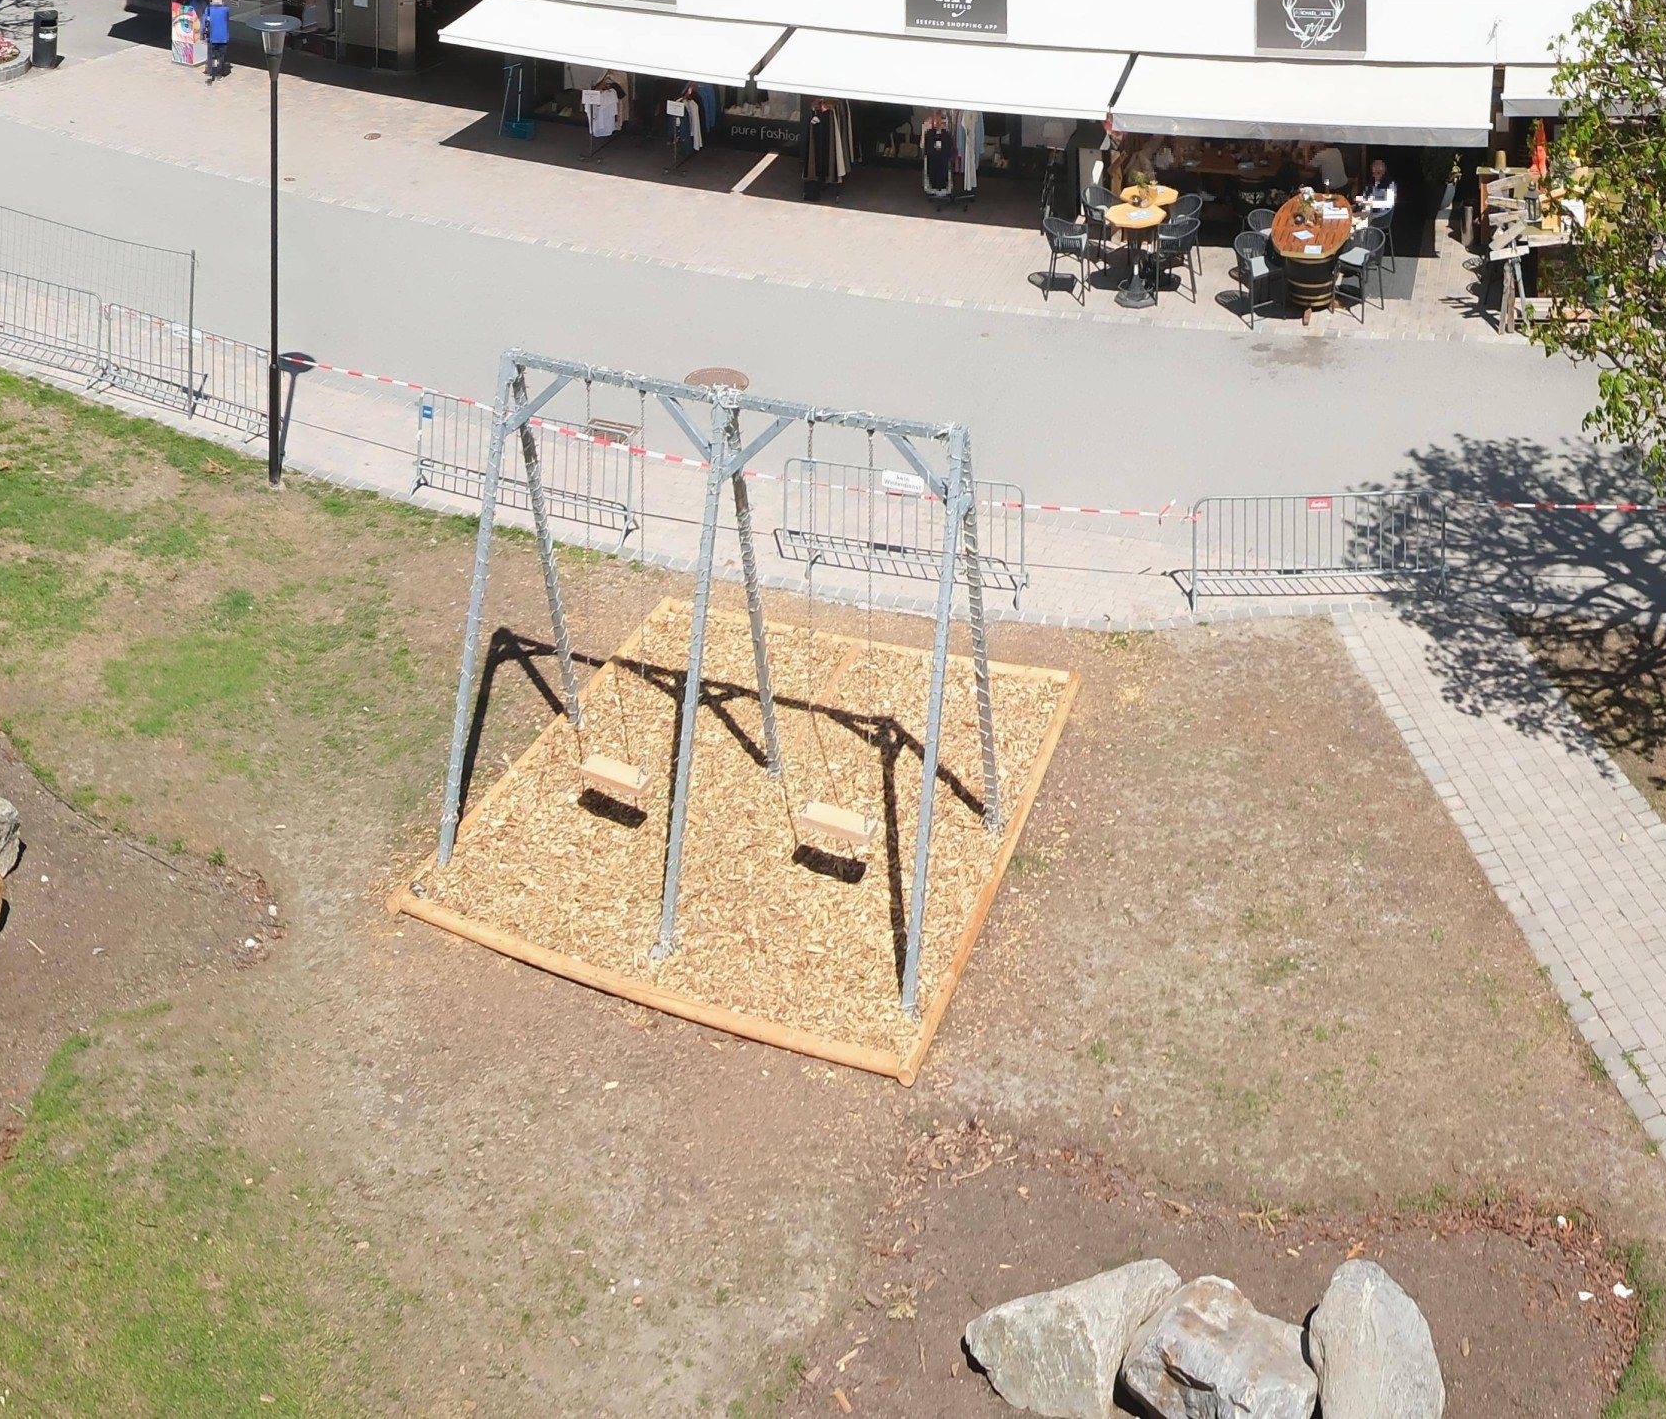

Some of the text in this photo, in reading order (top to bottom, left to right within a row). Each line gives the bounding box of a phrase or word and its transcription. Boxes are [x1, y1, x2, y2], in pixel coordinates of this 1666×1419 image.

[942, 3, 972, 11] SEEFELD
[915, 18, 945, 27] SEEFELD
[946, 20, 983, 30] SHOPPING
[731, 124, 757, 138] pure
